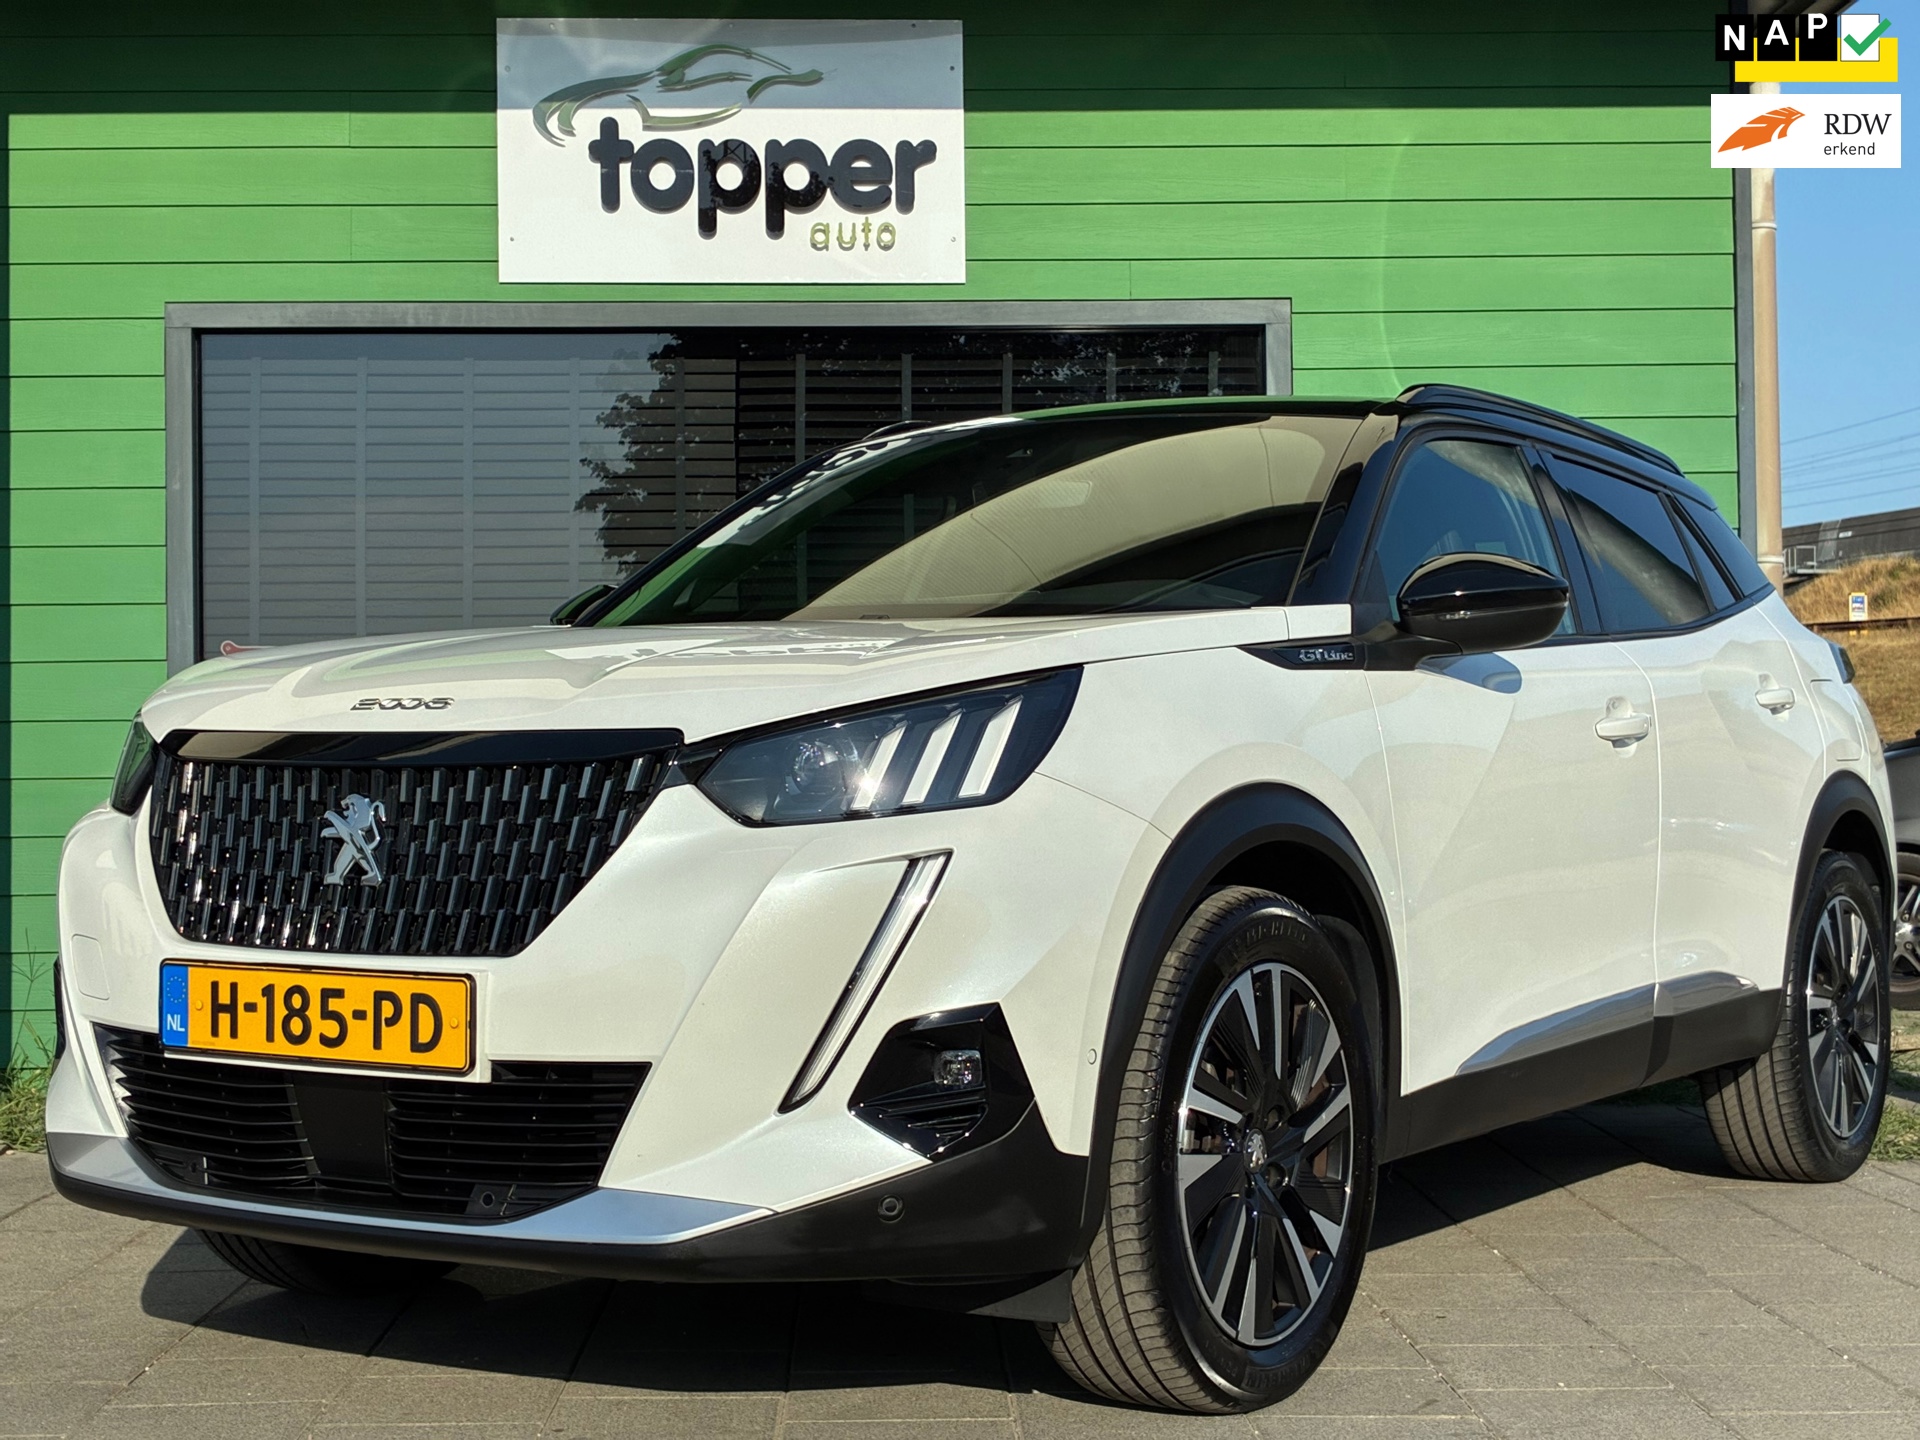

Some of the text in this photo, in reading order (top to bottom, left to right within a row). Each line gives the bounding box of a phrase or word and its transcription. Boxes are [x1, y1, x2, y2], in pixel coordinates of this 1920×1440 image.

[588, 116, 938, 240] topper
[810, 216, 897, 251] auto
[166, 1013, 185, 1032] NL
[210, 980, 443, 1053] H-185-PD
